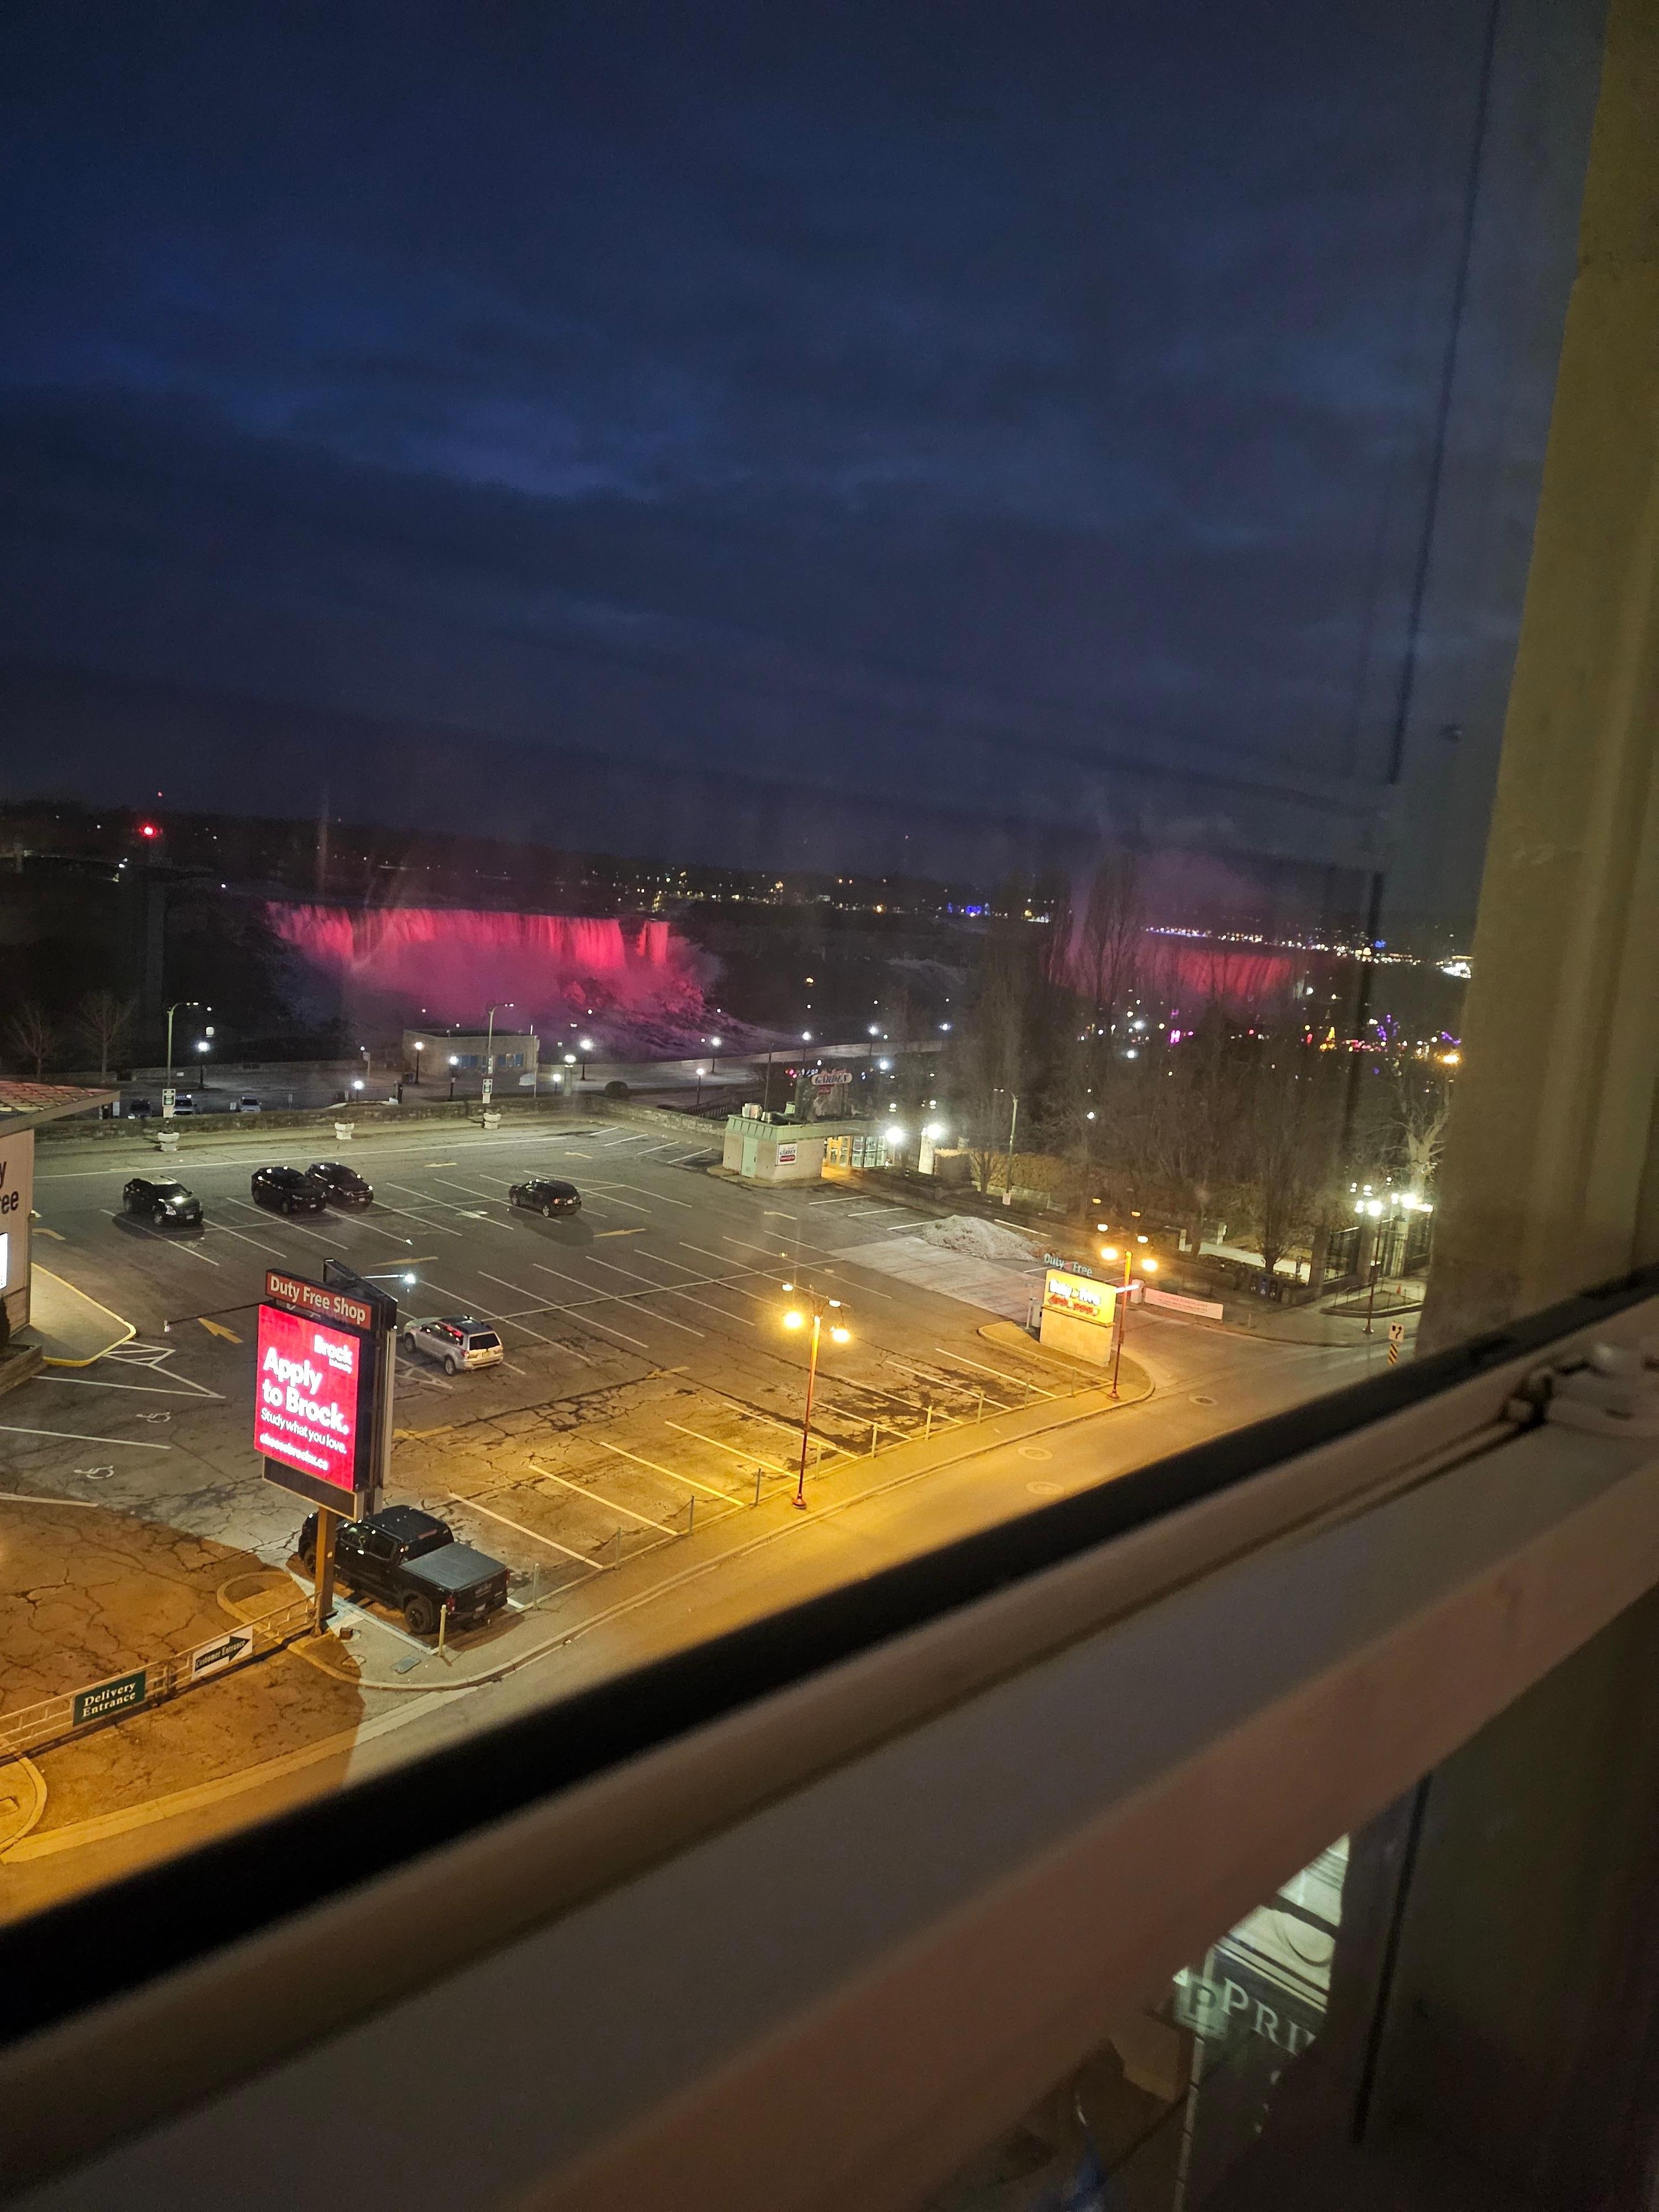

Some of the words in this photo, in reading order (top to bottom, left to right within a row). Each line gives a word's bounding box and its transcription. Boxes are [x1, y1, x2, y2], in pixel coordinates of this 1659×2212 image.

[0, 1191, 19, 1215] ee
[1072, 1261, 1093, 1277] Free
[270, 1275, 300, 1303] Duty
[303, 1286, 330, 1310] Free
[333, 1296, 366, 1325] Shop
[314, 1334, 353, 1366] Brock
[263, 1347, 323, 1395] Apply
[262, 1379, 283, 1407] to
[285, 1385, 349, 1435] Brock.
[260, 1407, 285, 1430] Study
[285, 1420, 308, 1438] what
[308, 1430, 326, 1443] you
[326, 1433, 347, 1454] love.
[196, 1651, 221, 1668] Customer
[222, 1640, 246, 1656] Entrance
[82, 1692, 136, 1718] Entrance
[84, 1682, 136, 1707] Delivery
[1220, 1976, 1316, 2055] PRI
